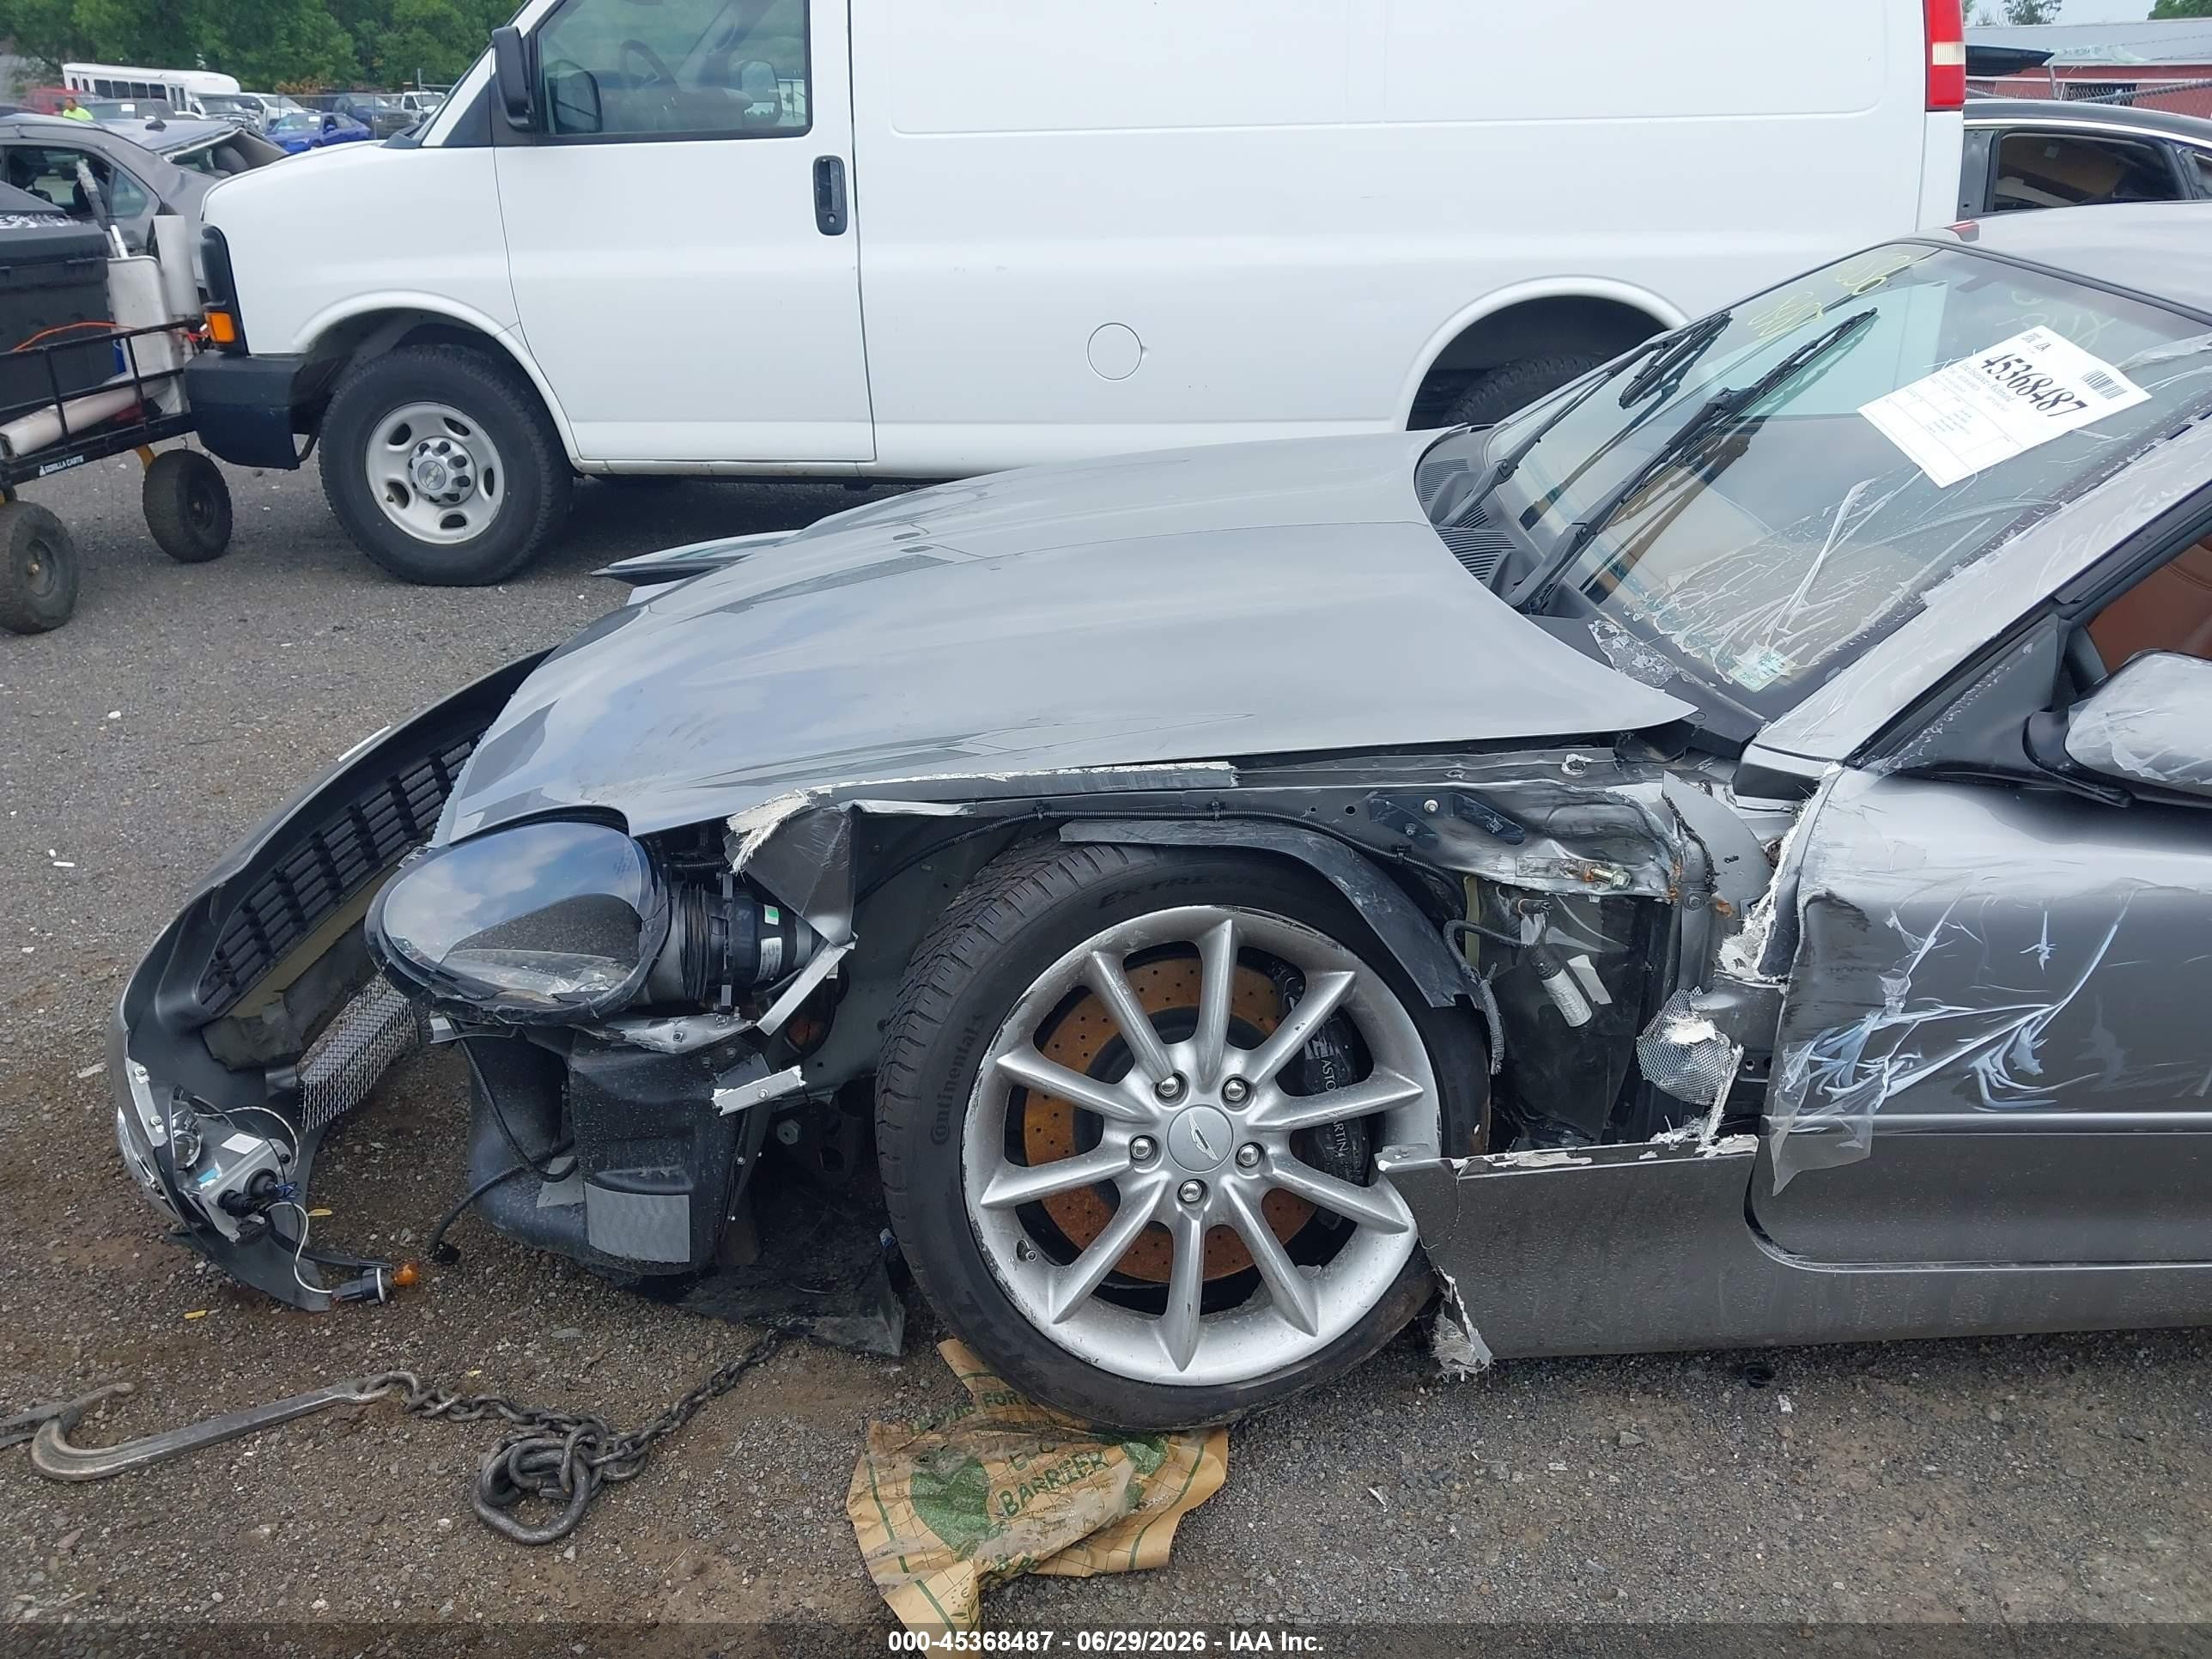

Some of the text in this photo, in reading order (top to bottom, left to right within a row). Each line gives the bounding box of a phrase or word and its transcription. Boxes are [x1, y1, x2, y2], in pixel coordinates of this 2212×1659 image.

[1981, 353, 2088, 417] 45368487
[930, 1027, 979, 1146] Continental
[1320, 1059, 1349, 1155] ASTO RTIN
[998, 1449, 1110, 1517] BARRIER
